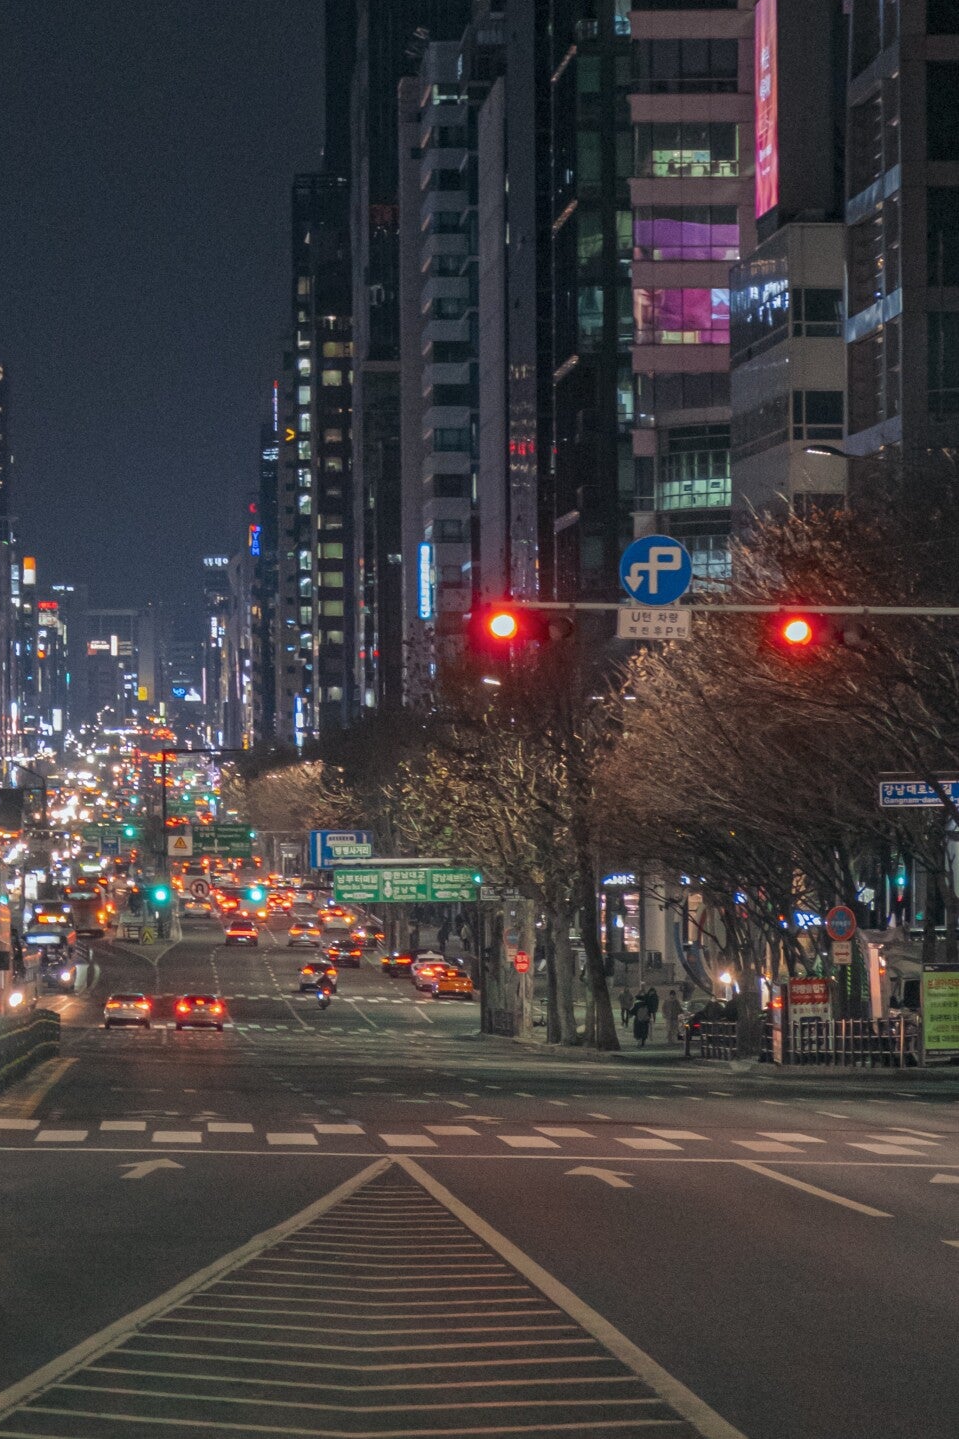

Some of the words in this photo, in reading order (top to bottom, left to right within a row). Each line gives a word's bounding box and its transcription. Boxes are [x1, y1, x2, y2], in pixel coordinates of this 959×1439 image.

[631, 610, 652, 623] U턴
[657, 610, 679, 623] 차량
[883, 784, 953, 796] 강남대로5길
[336, 874, 379, 884] 남부터미널
[393, 871, 426, 880] 한남대교
